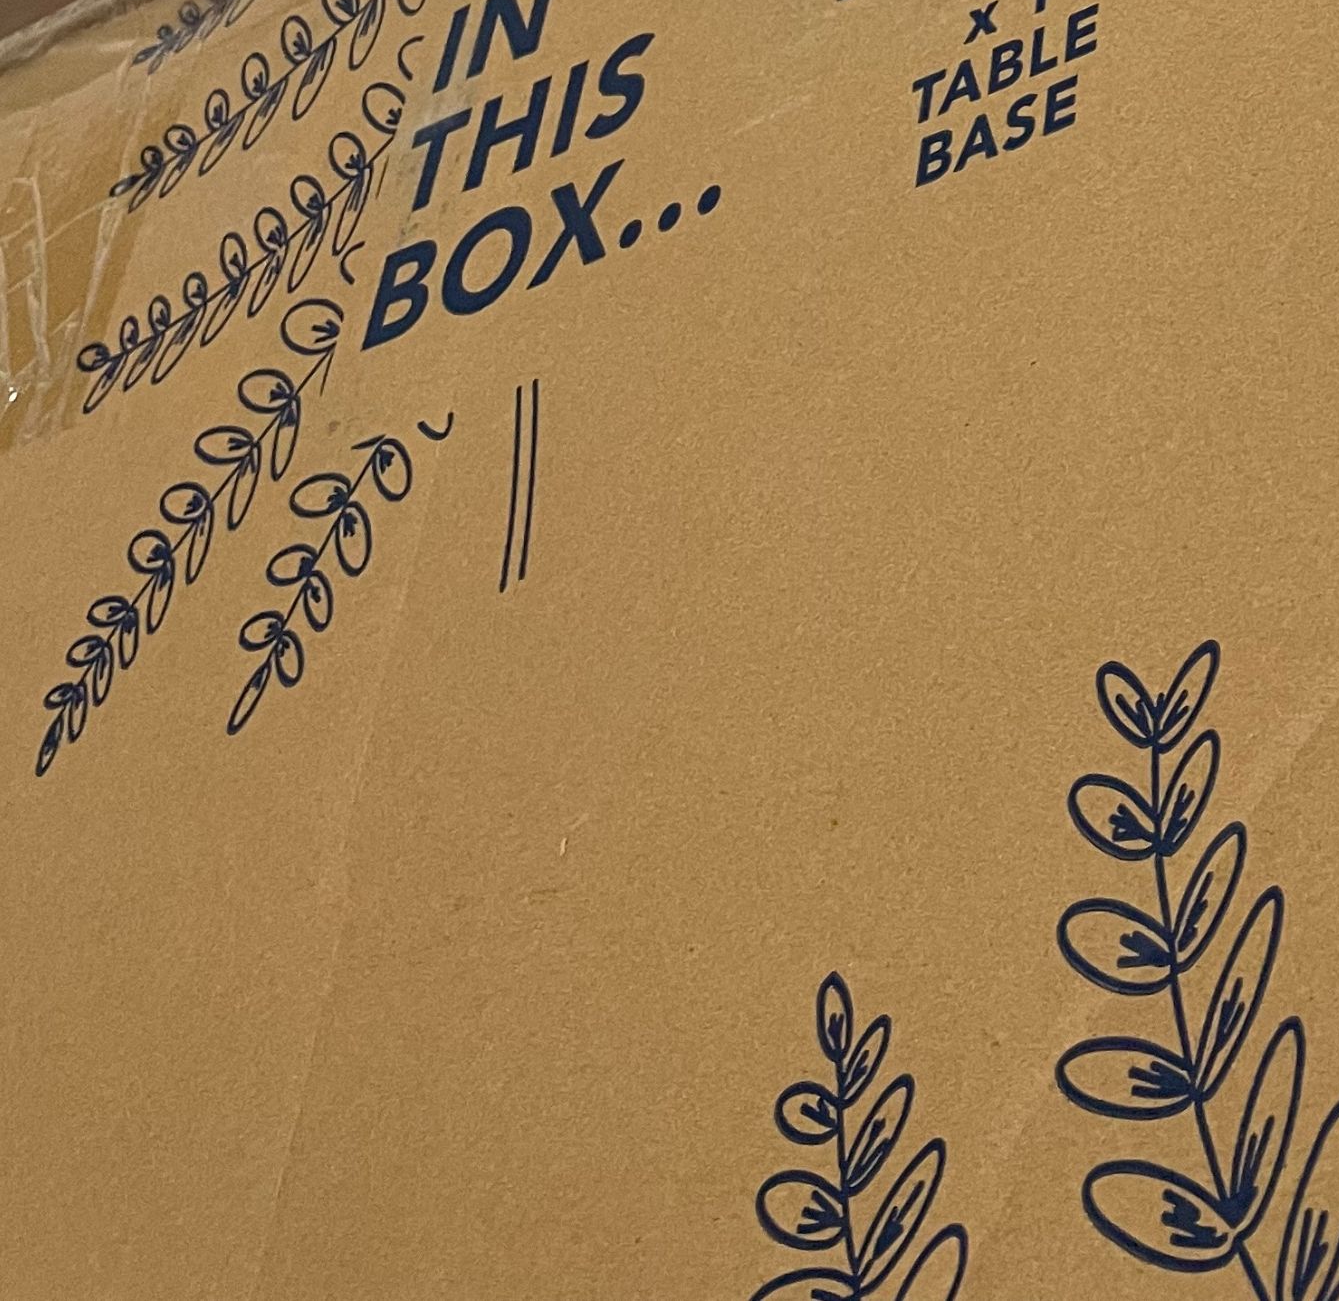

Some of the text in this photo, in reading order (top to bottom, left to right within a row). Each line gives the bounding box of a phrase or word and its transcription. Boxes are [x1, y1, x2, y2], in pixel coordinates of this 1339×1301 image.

[911, 2, 1100, 125] TABLE
[963, 0, 1000, 45] x
[411, 32, 656, 212] THIS
[914, 74, 1080, 188] BASE
[361, 158, 723, 352] BOX...
